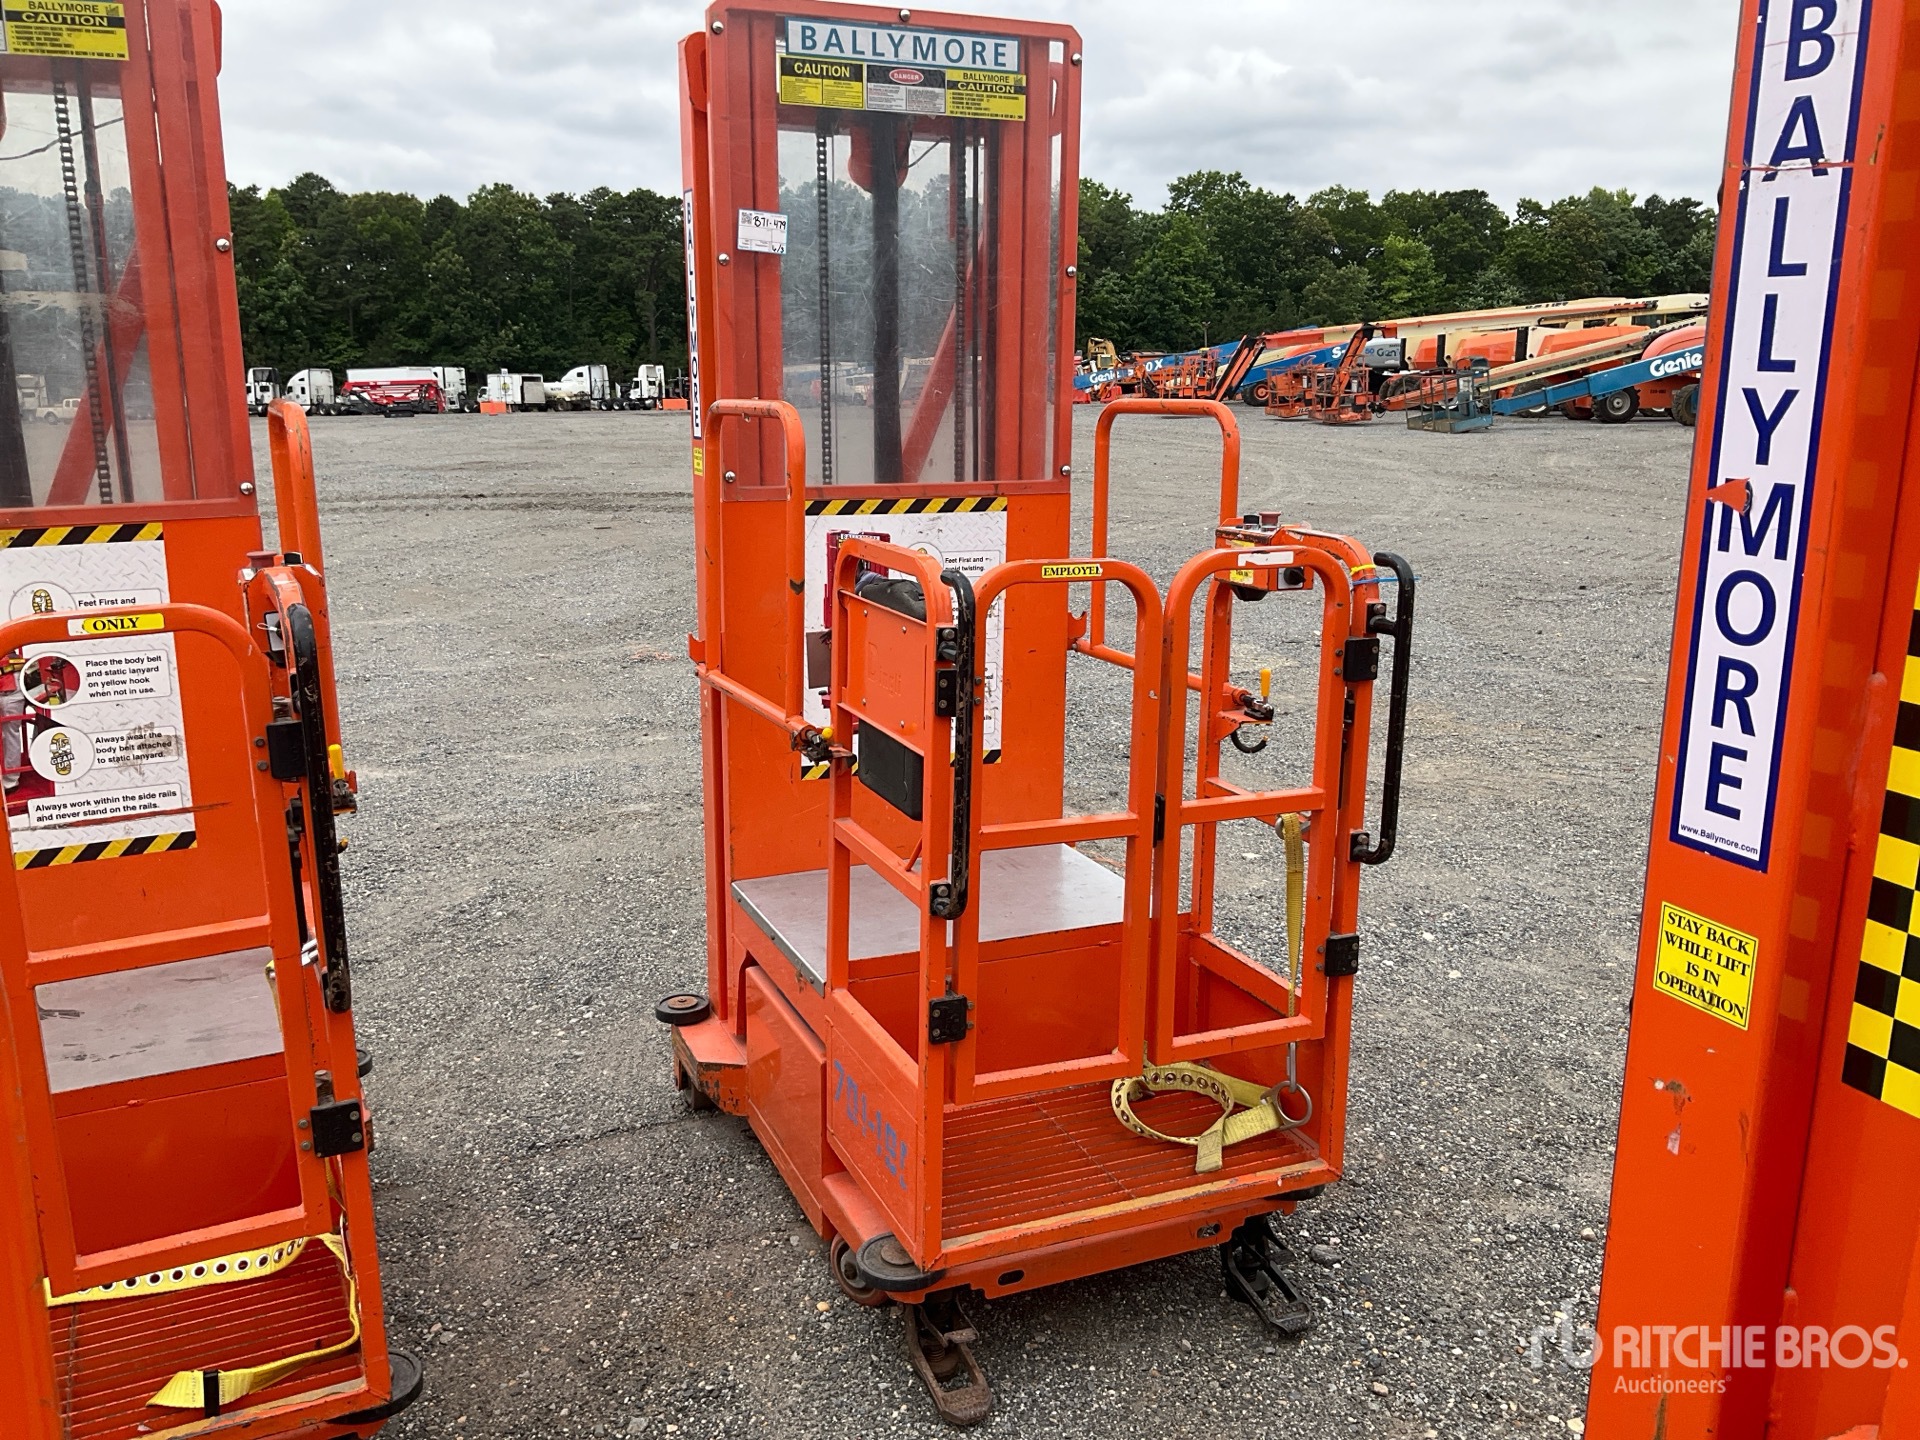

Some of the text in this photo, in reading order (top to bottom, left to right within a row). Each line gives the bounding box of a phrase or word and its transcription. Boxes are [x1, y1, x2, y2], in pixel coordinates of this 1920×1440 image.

[28, 0, 99, 13] BALLYMORE
[22, 12, 108, 26] CAUTION
[801, 25, 1006, 67] BALLYMORE
[794, 62, 850, 78] CAUTION
[963, 72, 1010, 83] BALLYMORE
[958, 82, 1014, 93] CAUTION
[686, 202, 700, 428] BALLYMORE
[1650, 352, 1703, 376] Genie
[1705, 0, 1838, 820] BALLYMORE
[92, 617, 140, 631] ONLY
[86, 660, 108, 668] Place
[110, 658, 123, 666] the
[124, 656, 145, 666] body
[86, 666, 160, 678] and static lanyard
[101, 678, 128, 688] yellow
[129, 676, 150, 684] hook
[89, 690, 112, 698] when
[95, 731, 162, 744] Always wear the
[96, 740, 172, 756] body belt attached
[51, 753, 75, 766] GEAR
[108, 754, 130, 763] static
[132, 751, 166, 762] lanyard.
[58, 761, 70, 770] UP
[35, 790, 177, 814] Always work within the side rails
[36, 813, 54, 822] and
[56, 812, 80, 820] never
[82, 808, 108, 817] stand
[122, 804, 137, 812] the
[138, 802, 160, 810] rails.
[1680, 822, 1759, 856] www.Ballymore.com
[1668, 911, 1750, 956] STAY BACK
[1664, 930, 1750, 976] WHILE LIFT
[1685, 960, 1722, 988] IS IN
[1658, 970, 1745, 1020] OPERATION
